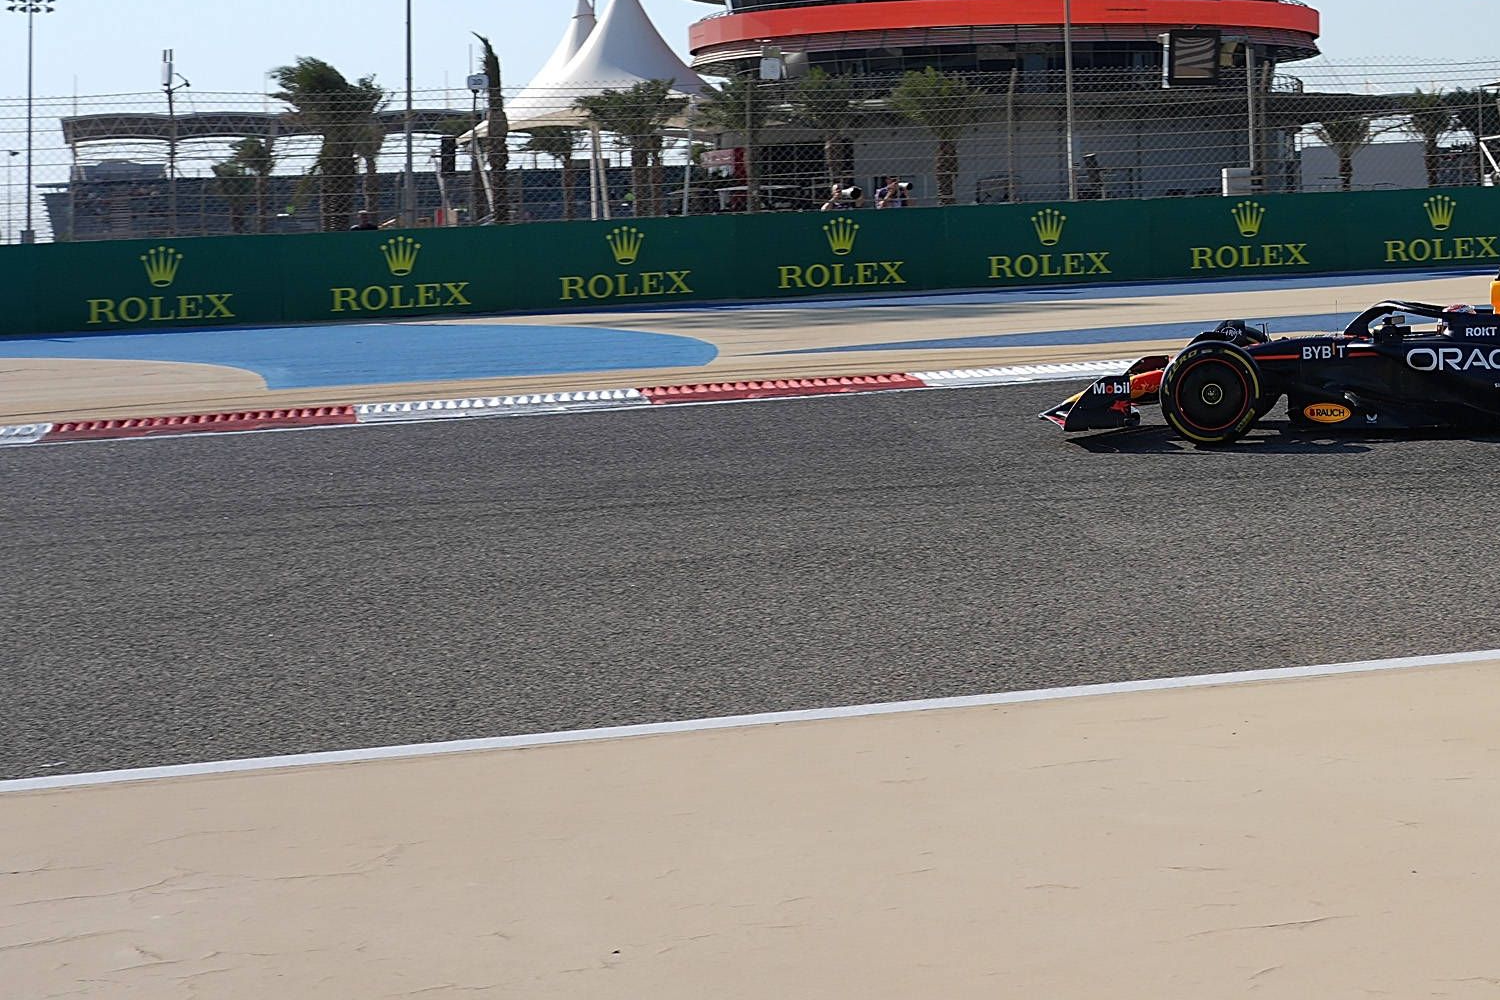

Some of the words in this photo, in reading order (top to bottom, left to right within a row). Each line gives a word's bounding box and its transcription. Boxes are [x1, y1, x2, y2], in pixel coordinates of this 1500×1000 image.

[1191, 244, 1309, 268] ROLEX
[1384, 237, 1500, 261] ROLEX
[778, 262, 905, 288] ROLEX
[988, 252, 1111, 278] ROLEX
[331, 282, 471, 311] ROLEX
[560, 271, 693, 299] ROLEX
[88, 294, 234, 323] ROLEX
[1465, 326, 1498, 337] ROKT
[1302, 342, 1346, 360] BYBIT
[1093, 382, 1130, 395] Mobil
[1315, 408, 1345, 417] RAUCH
